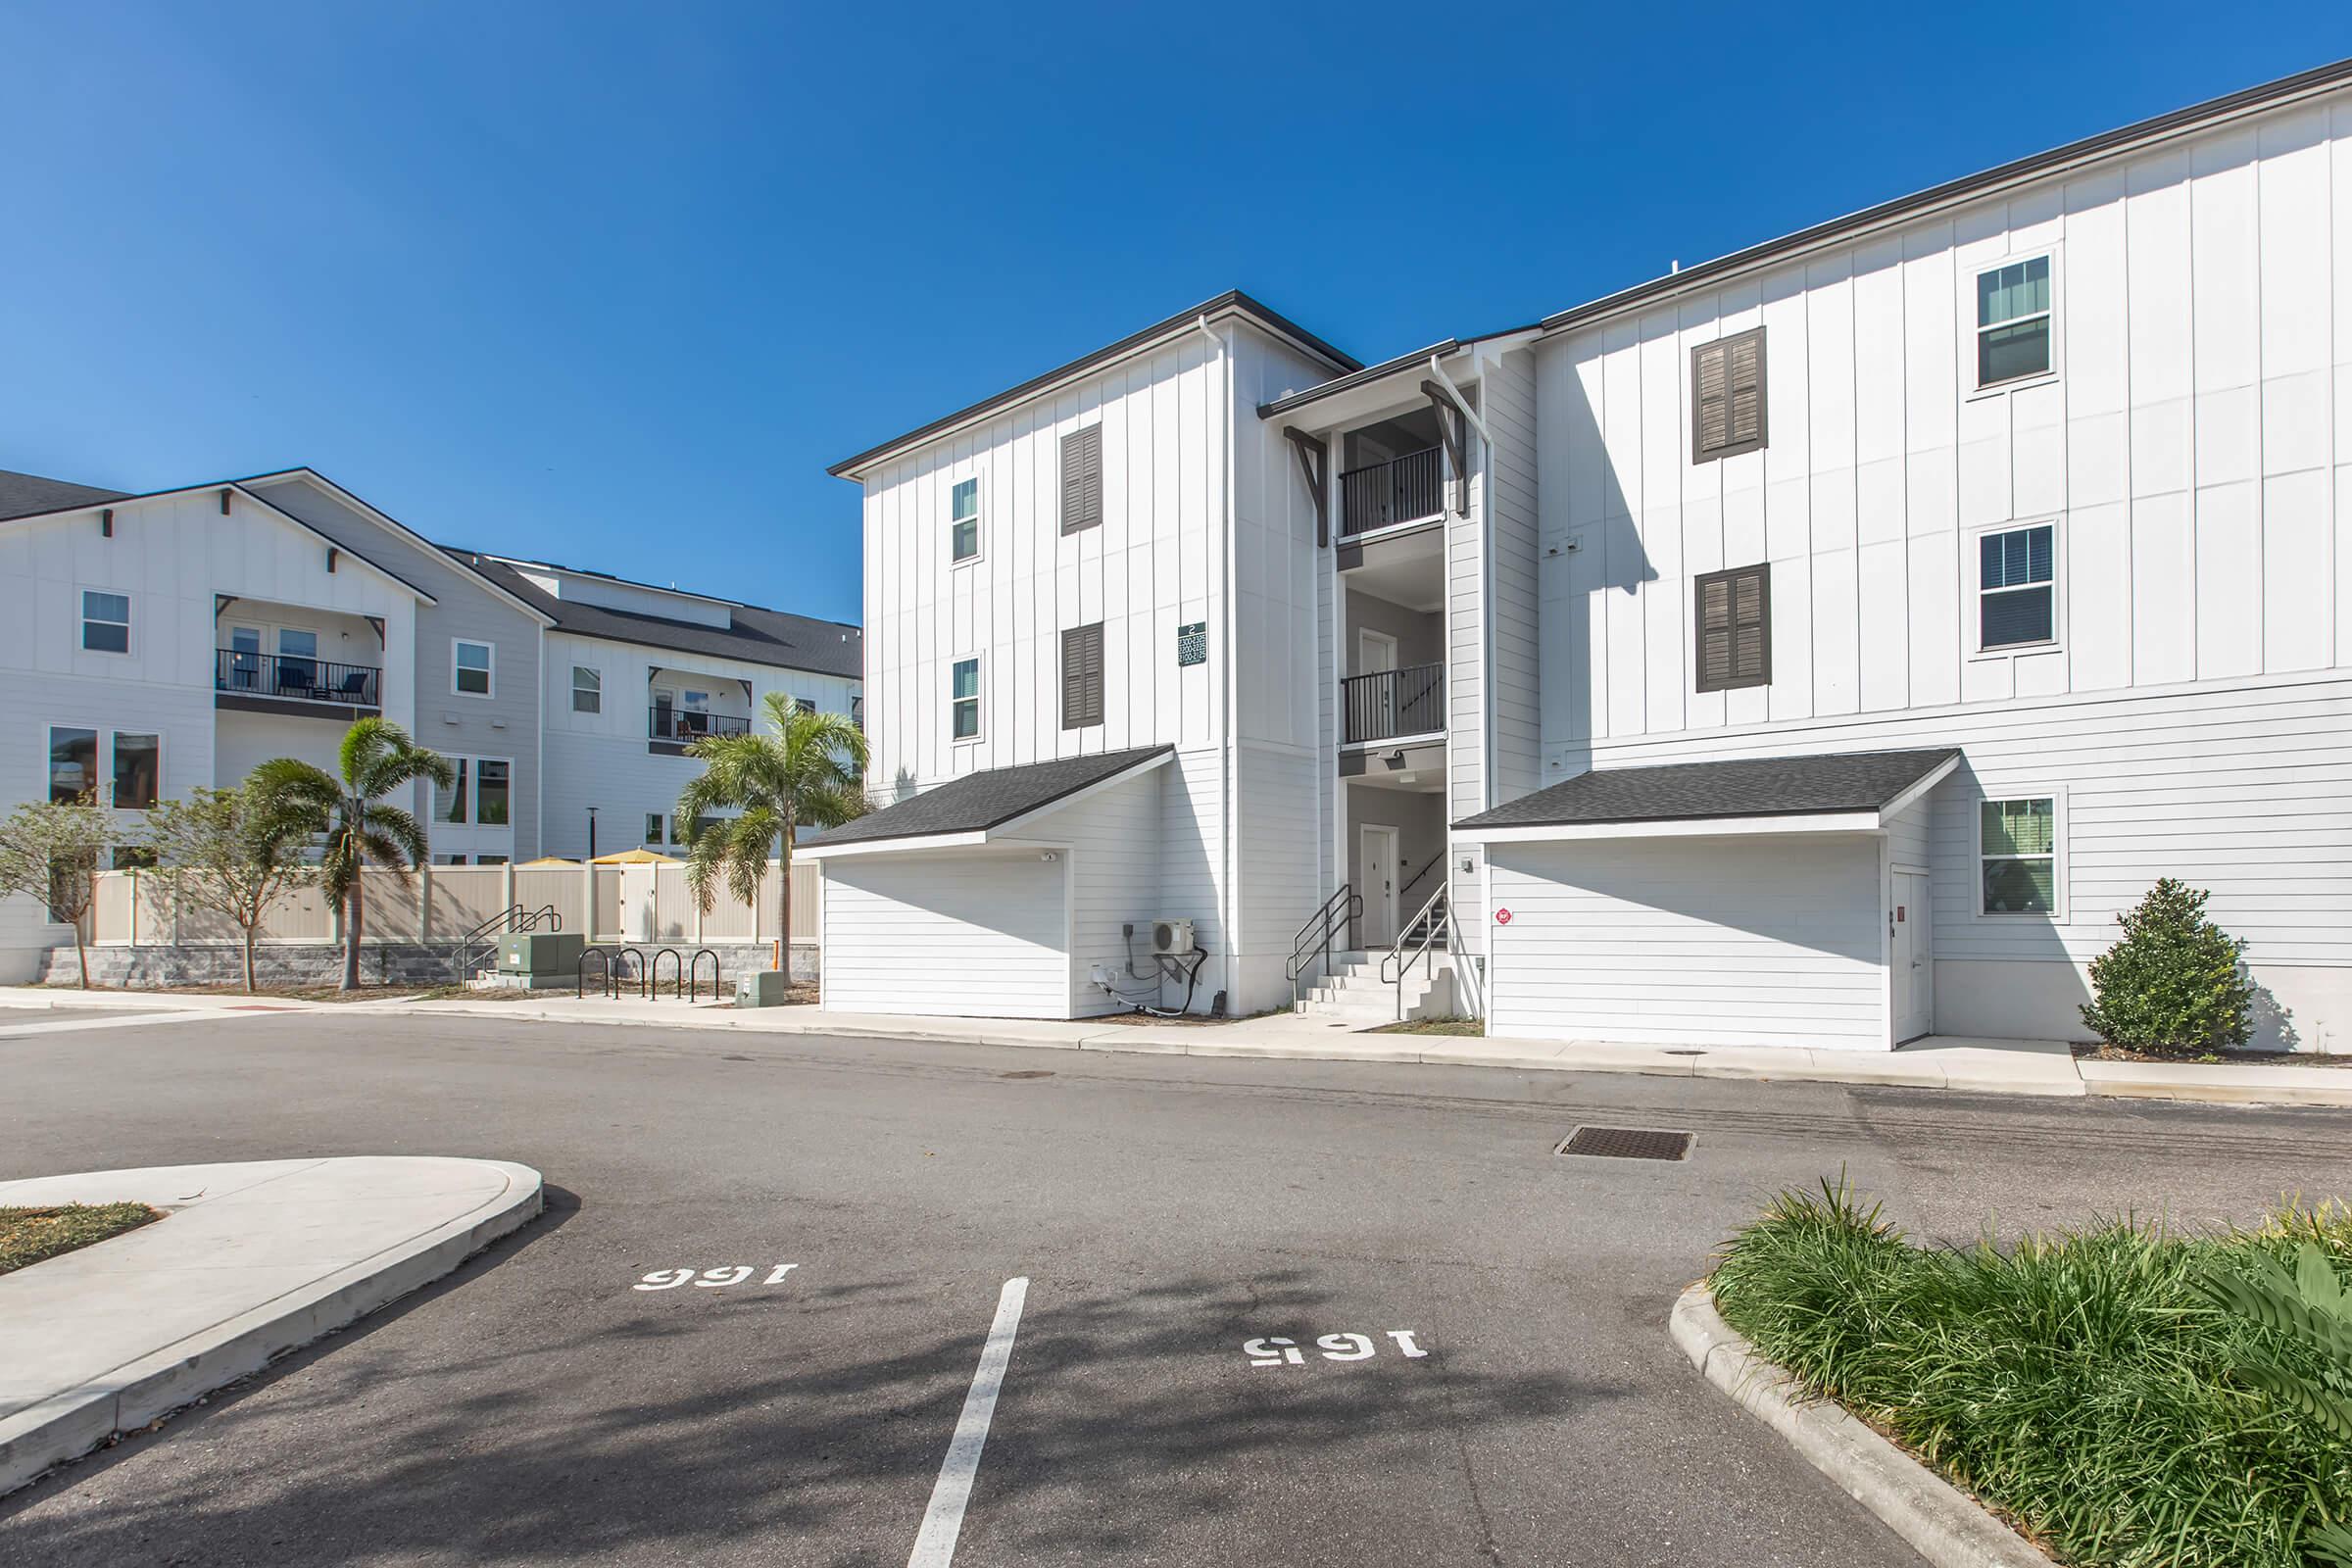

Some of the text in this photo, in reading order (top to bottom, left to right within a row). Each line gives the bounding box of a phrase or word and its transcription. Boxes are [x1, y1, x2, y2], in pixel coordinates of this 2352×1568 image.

[1189, 624, 1196, 635] 2
[633, 1263, 799, 1291] 166
[1244, 1330, 1429, 1366] 165
